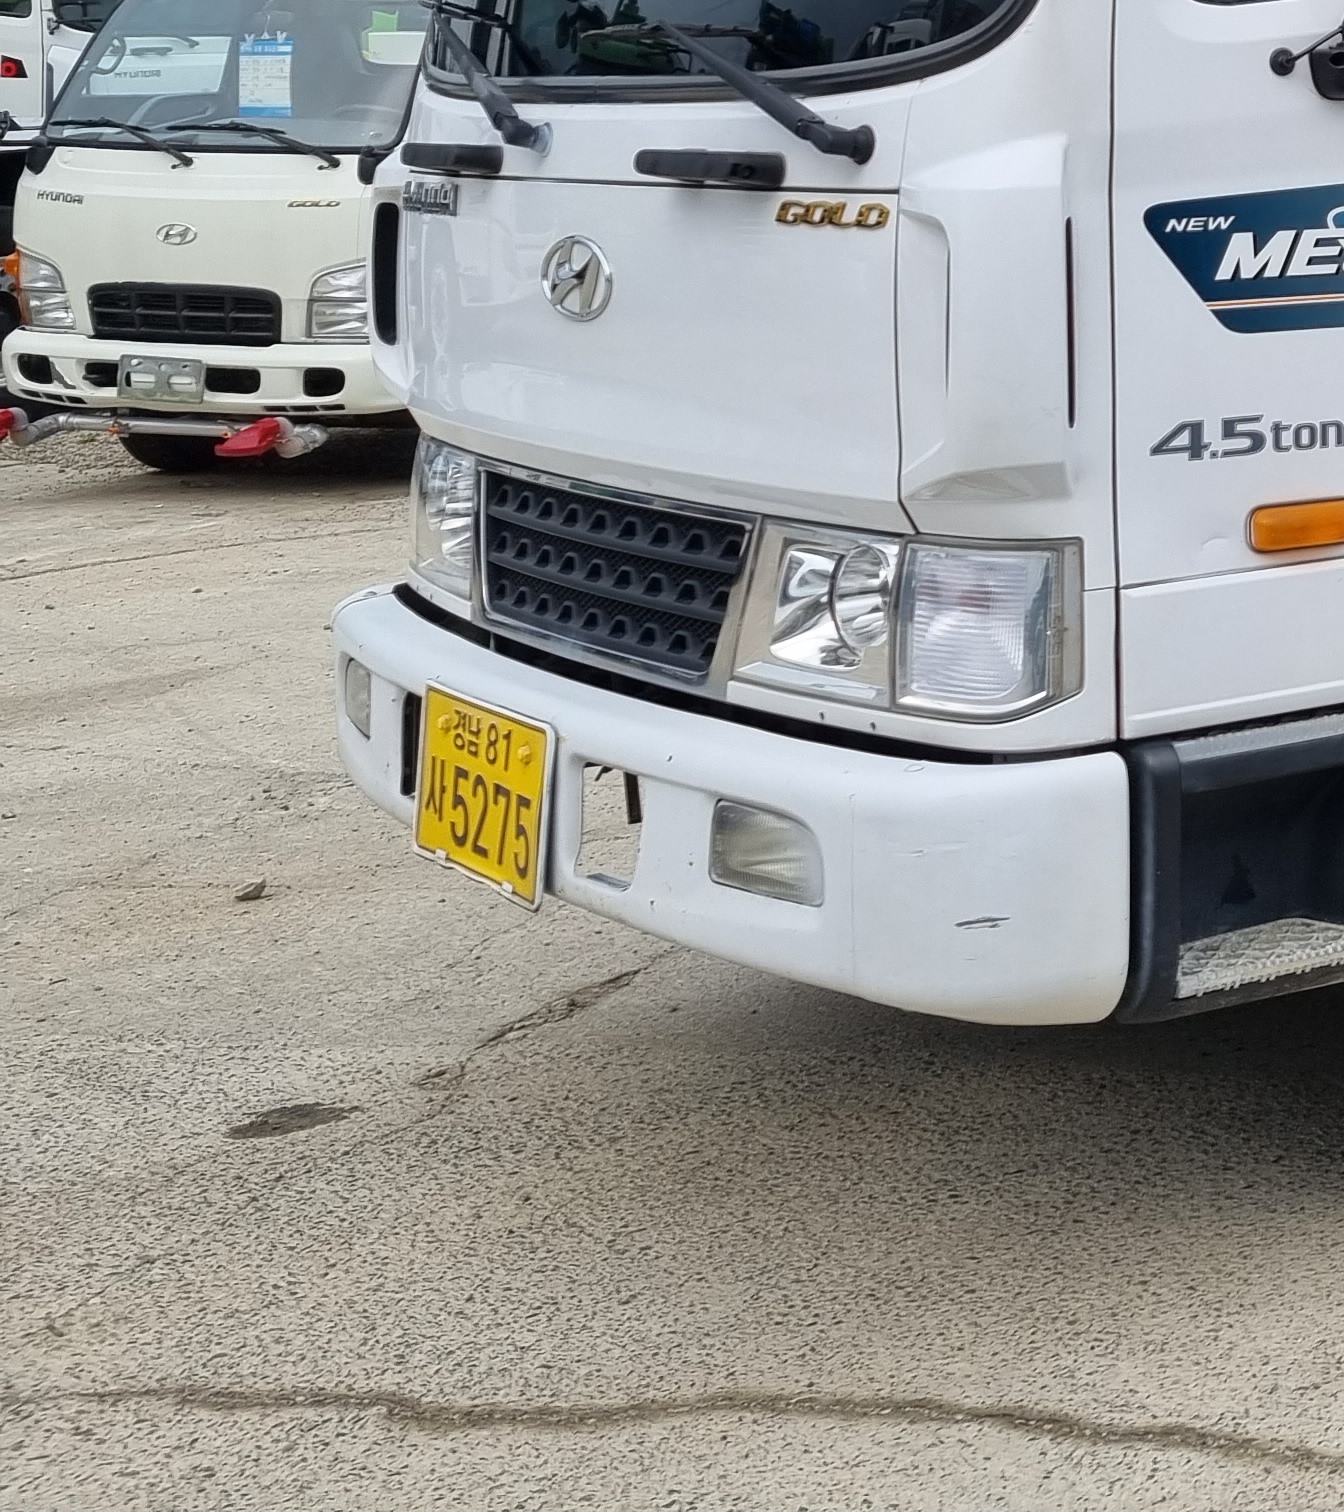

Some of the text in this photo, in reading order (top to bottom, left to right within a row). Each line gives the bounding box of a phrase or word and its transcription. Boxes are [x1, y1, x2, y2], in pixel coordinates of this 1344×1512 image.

[37, 189, 84, 205] HYUNDAI
[287, 200, 341, 208] GOLD
[775, 199, 890, 229] GOLD
[1165, 215, 1236, 233] NEW
